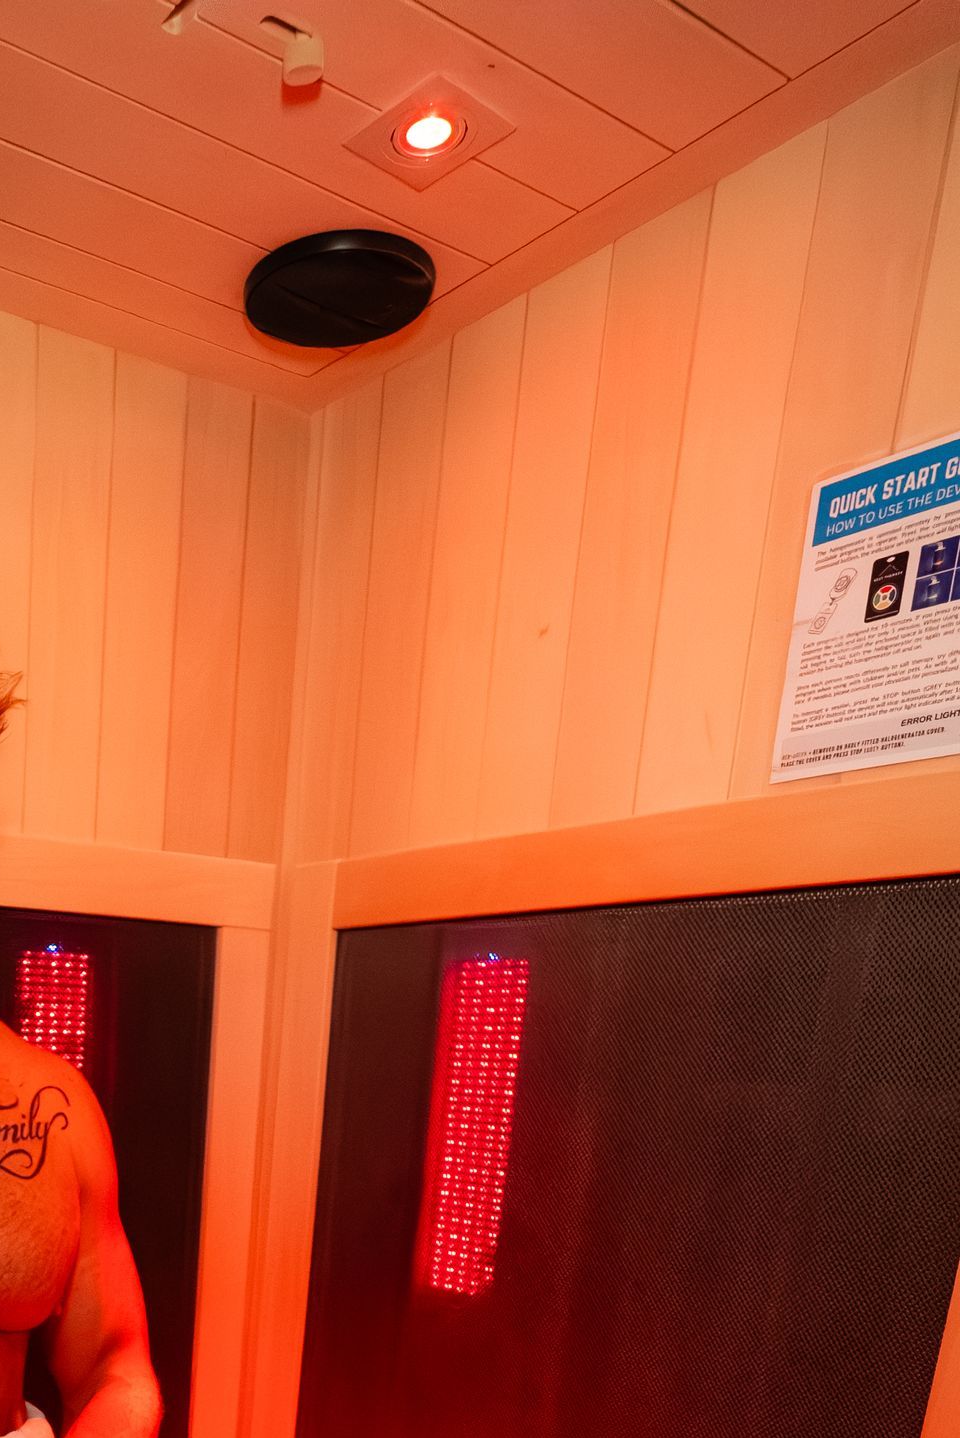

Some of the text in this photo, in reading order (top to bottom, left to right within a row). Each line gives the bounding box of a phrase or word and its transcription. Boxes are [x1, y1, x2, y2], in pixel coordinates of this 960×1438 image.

[829, 456, 960, 518] QUICK START G
[826, 518, 856, 537] HOW
[859, 511, 876, 527] TO
[878, 503, 904, 519] USE
[907, 491, 933, 510] THE
[900, 714, 933, 726] ERROR
[844, 741, 860, 749] BADLY
[861, 738, 879, 746] FITTED
[833, 751, 849, 759] PRESS
[850, 748, 863, 756] STOP
